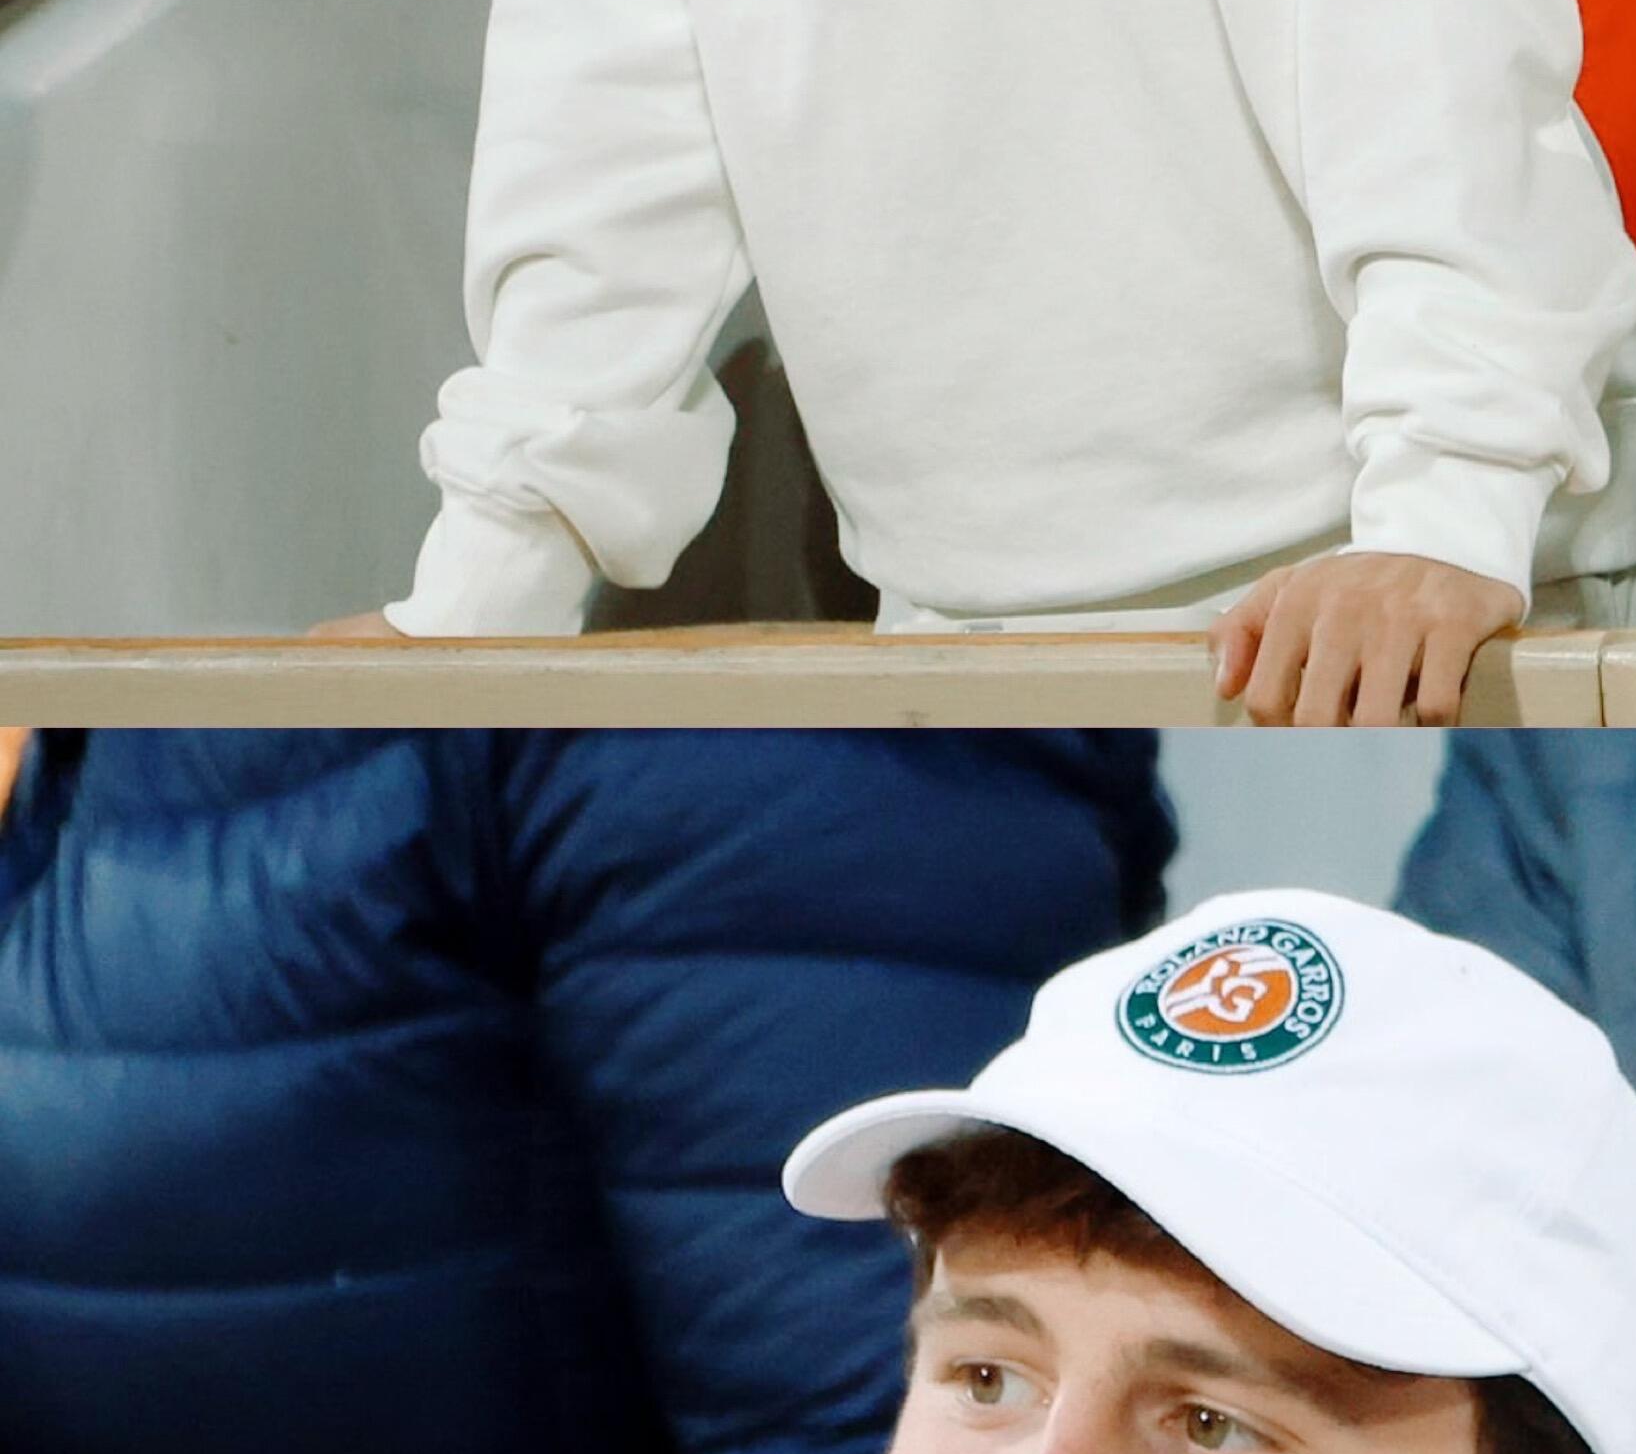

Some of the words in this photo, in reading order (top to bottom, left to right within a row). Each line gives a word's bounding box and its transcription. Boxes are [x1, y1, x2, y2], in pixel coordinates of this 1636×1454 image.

[1135, 927, 1268, 995] ROLAND
[1272, 932, 1329, 1039] GARROS
[1135, 1014, 1257, 1062] PARIS
